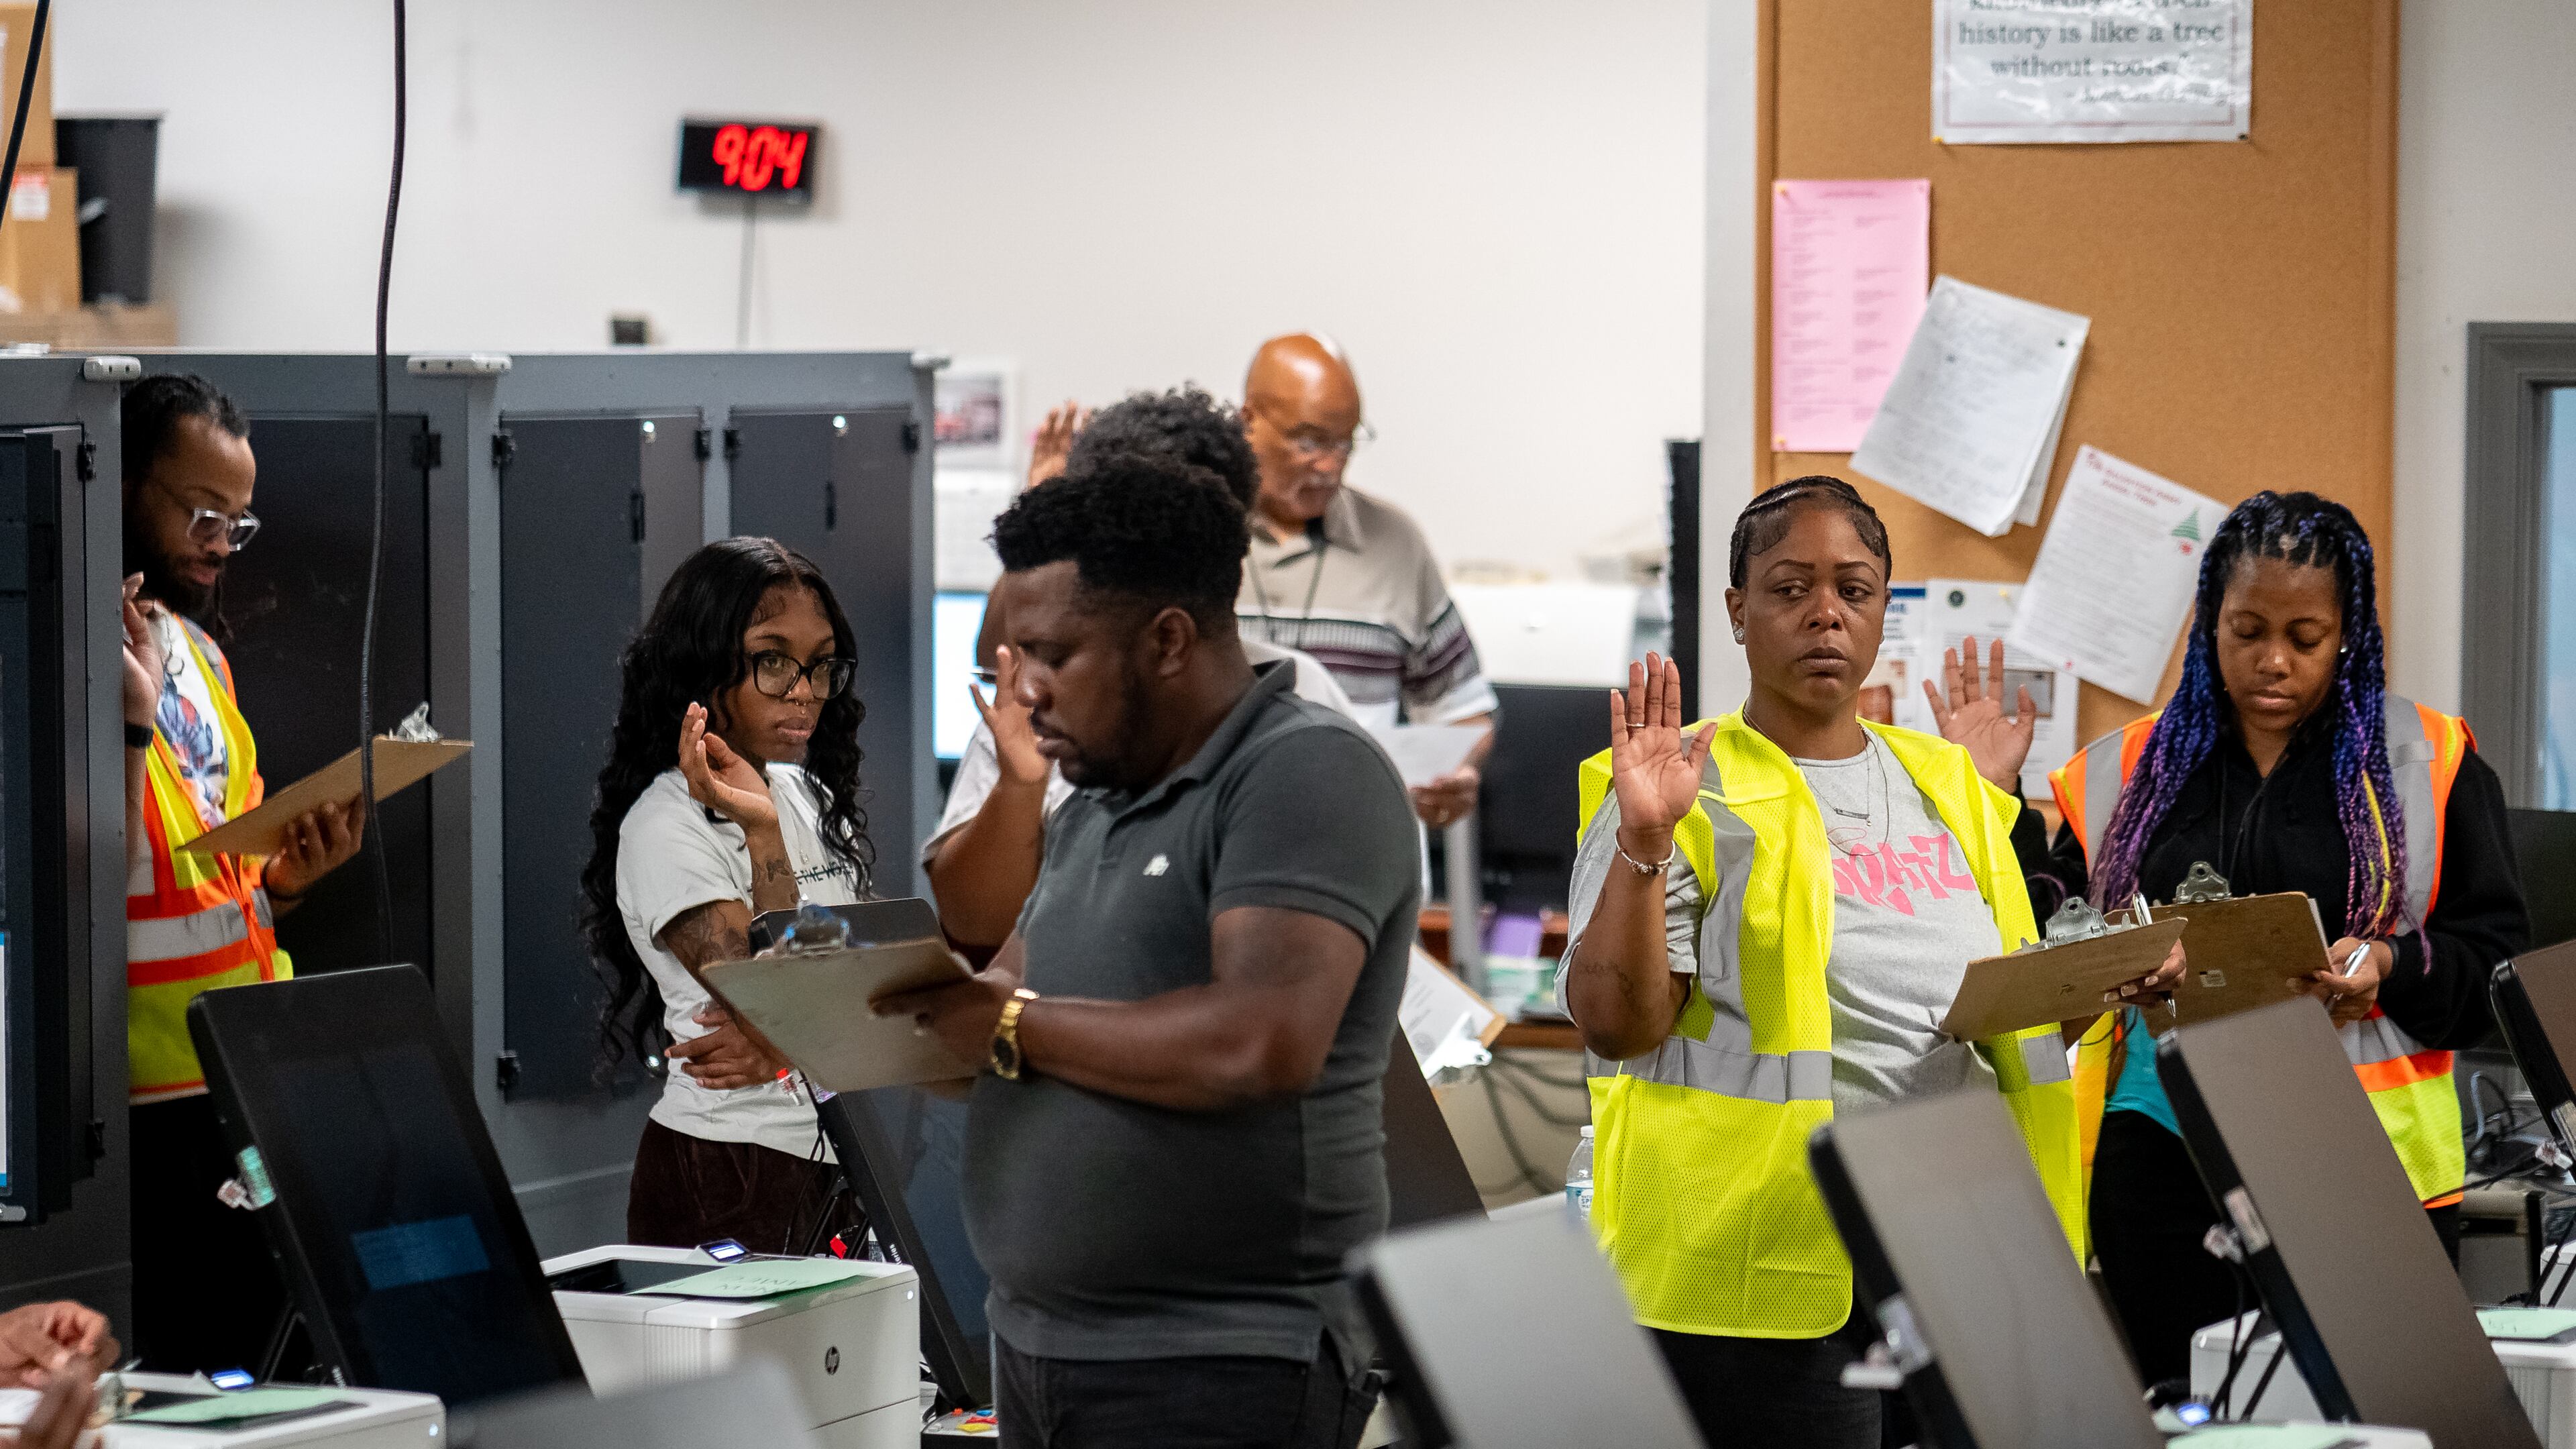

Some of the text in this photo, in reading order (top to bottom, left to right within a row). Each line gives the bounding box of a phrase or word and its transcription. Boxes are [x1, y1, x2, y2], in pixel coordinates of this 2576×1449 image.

[1959, 18, 2225, 50] history is like a tree
[1991, 54, 2092, 76] without
